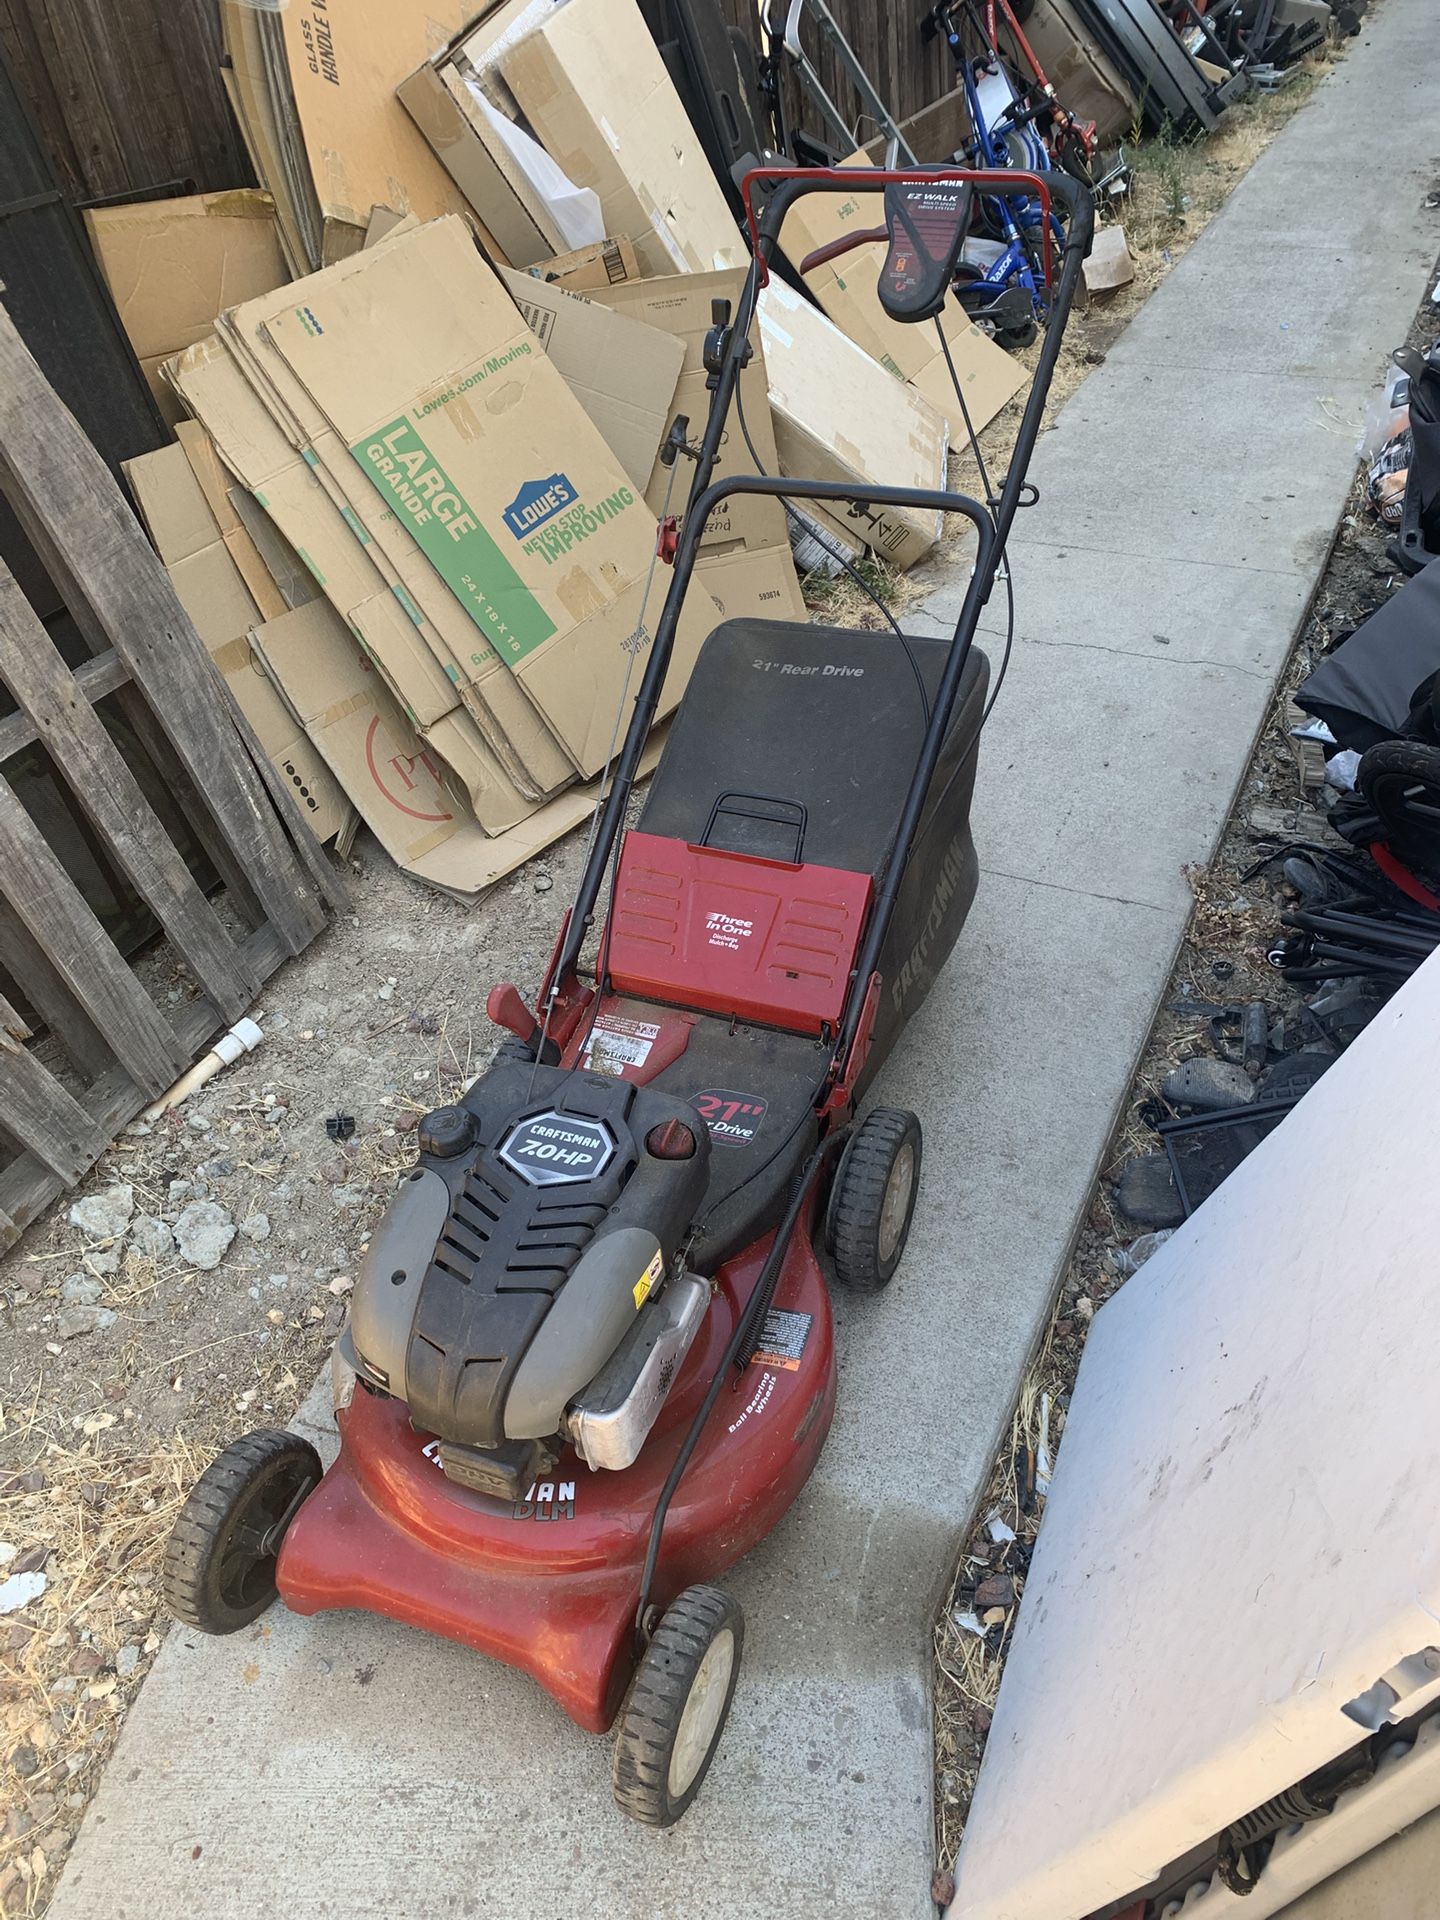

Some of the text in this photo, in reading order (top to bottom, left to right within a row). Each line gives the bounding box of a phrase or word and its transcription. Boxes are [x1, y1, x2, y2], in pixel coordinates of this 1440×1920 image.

[301, 19, 319, 74] GLASS
[313, 12, 339, 86] HANDLE
[924, 193, 958, 201] WALK
[412, 341, 532, 420] Lowes.com/Moving
[367, 444, 432, 526] GRANDE
[382, 425, 477, 542] LARGE
[511, 484, 570, 531] LOWE'S
[522, 503, 586, 556] NEVER STOP
[535, 487, 634, 565] IMPROVING
[461, 574, 476, 592] 24
[485, 605, 499, 622] 18
[507, 635, 521, 652] 18
[780, 664, 819, 676] Rear
[821, 665, 865, 677] Drive
[706, 911, 753, 928] Three
[706, 921, 752, 937] In One
[530, 1124, 601, 1149] CRAFTSMAN
[713, 1121, 753, 1137] Drive
[729, 1372, 770, 1433] Ball Bearing
[755, 1376, 776, 1414] Wheels
[512, 1502, 575, 1521] DLM
